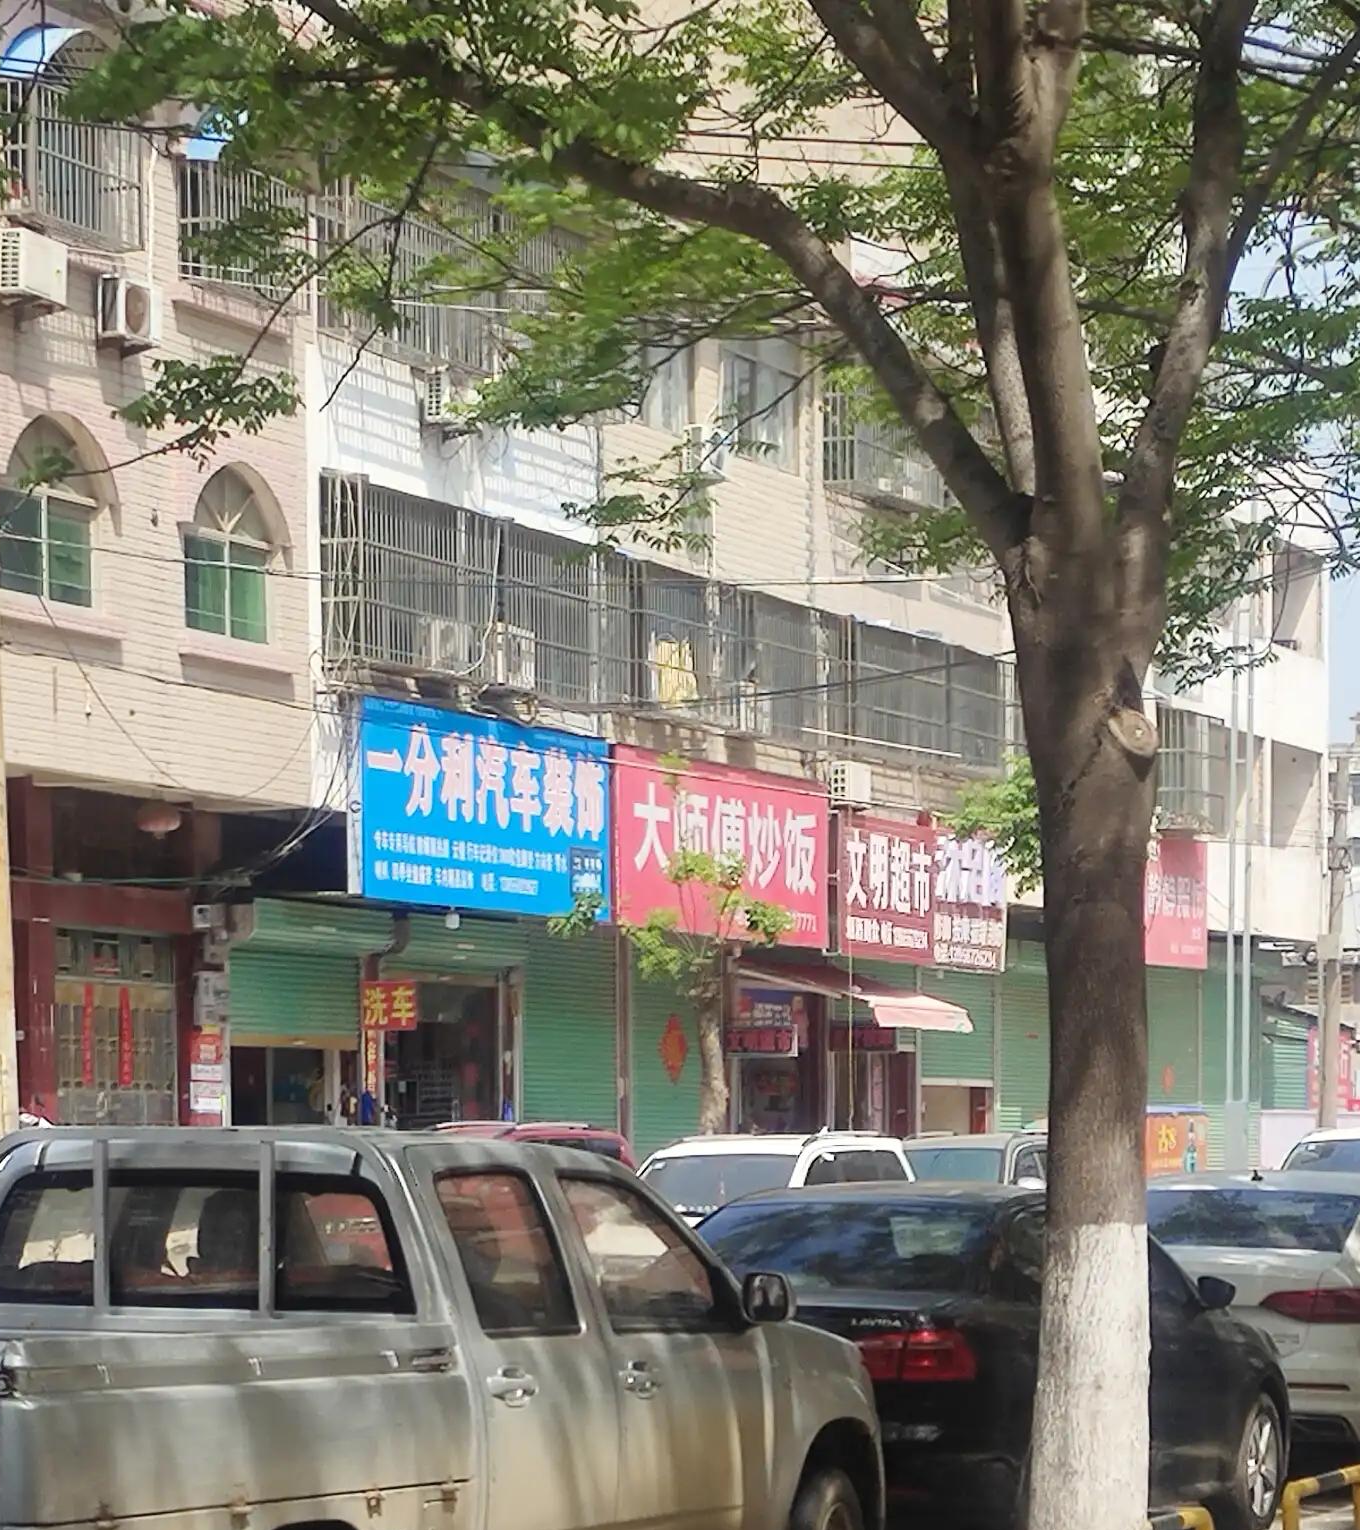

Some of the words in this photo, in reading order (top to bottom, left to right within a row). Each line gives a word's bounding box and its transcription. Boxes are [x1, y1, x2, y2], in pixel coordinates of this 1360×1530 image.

[367, 722, 606, 841] 一分利汽车装饰
[846, 829, 933, 918] 文明超市
[363, 985, 417, 1027] 洗车
